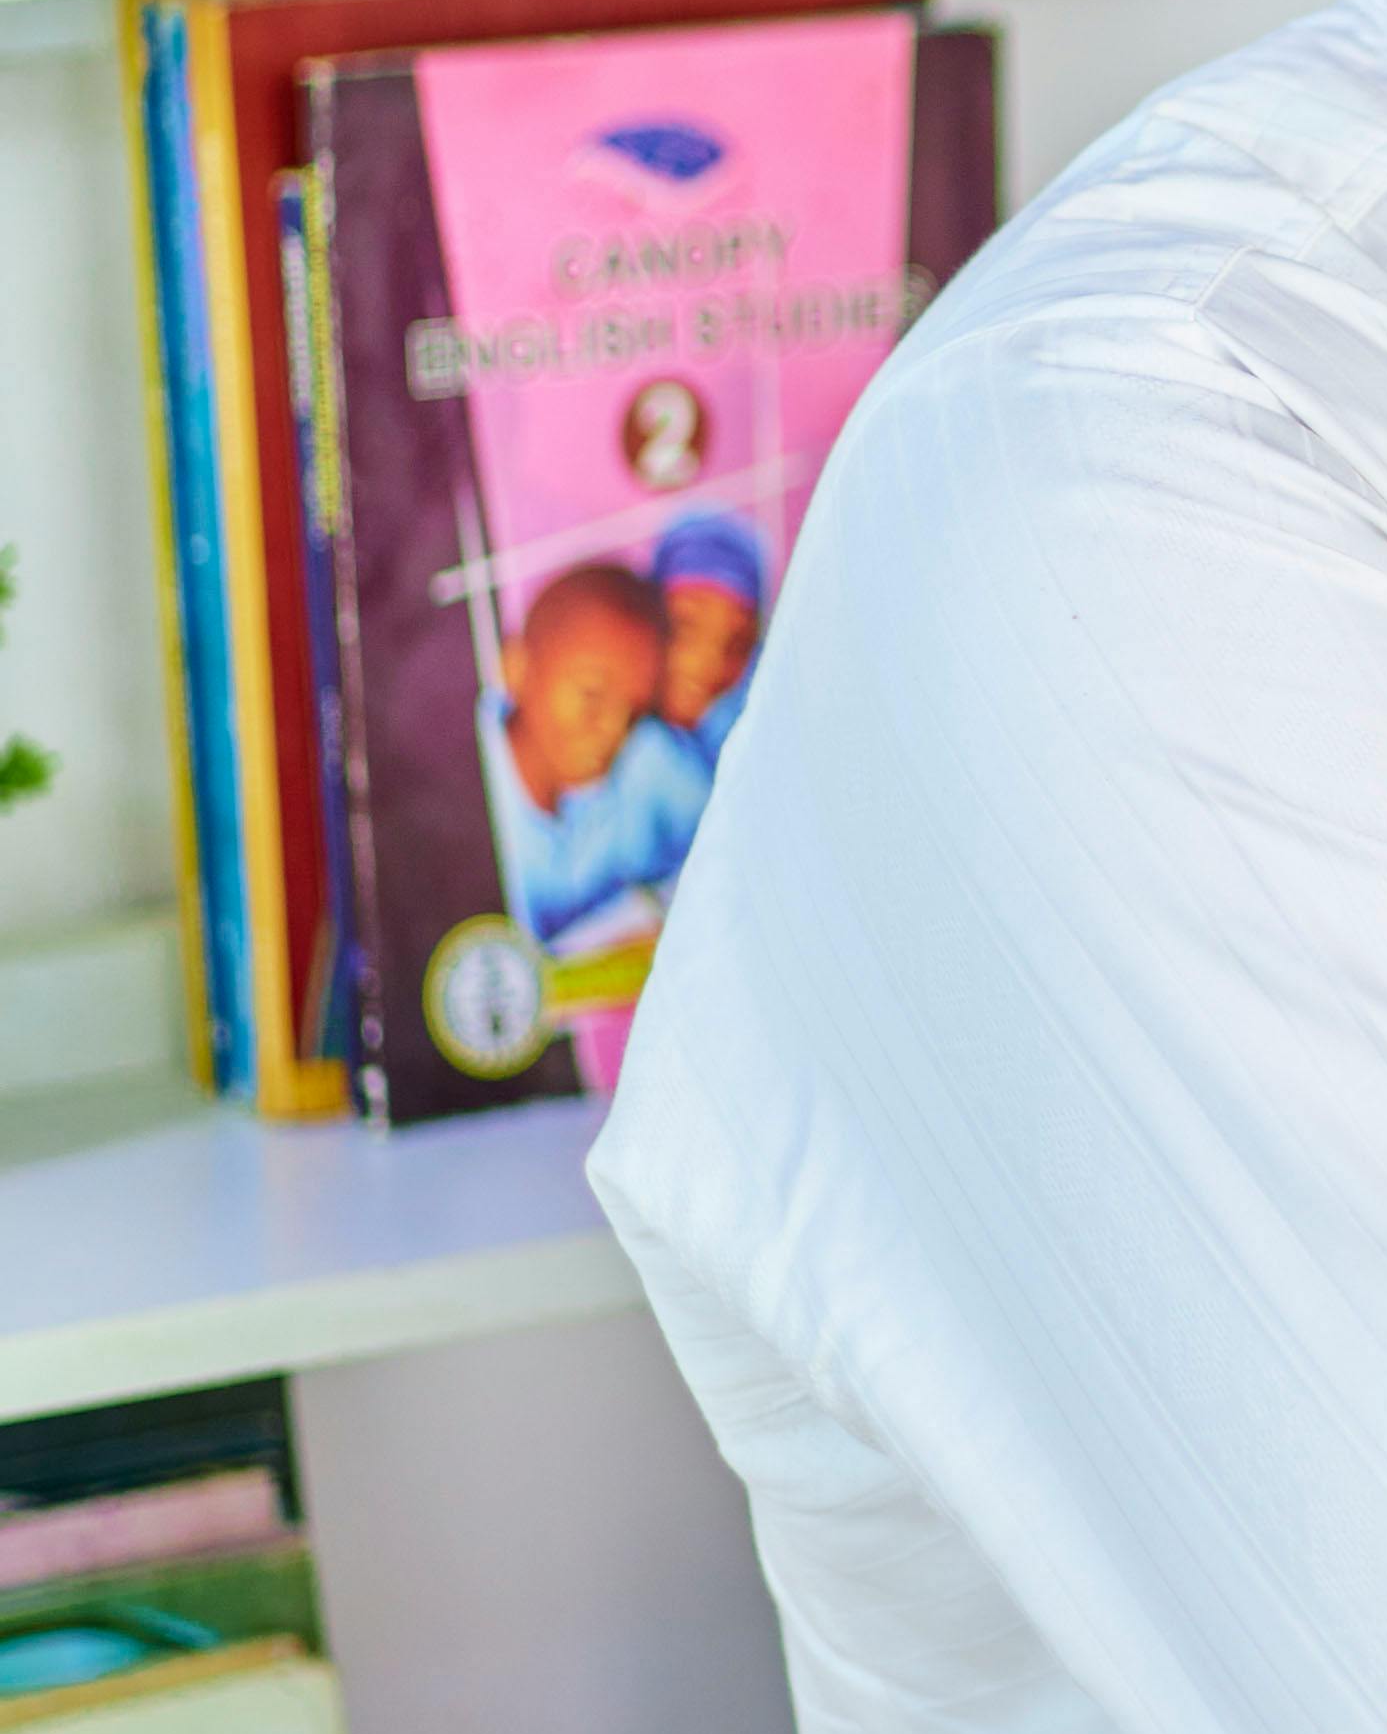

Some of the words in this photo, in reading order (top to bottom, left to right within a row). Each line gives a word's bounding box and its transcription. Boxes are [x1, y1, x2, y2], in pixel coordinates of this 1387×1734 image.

[552, 219, 793, 302] CANOPY
[406, 305, 677, 402] ENGLISH
[627, 379, 703, 492] 2
